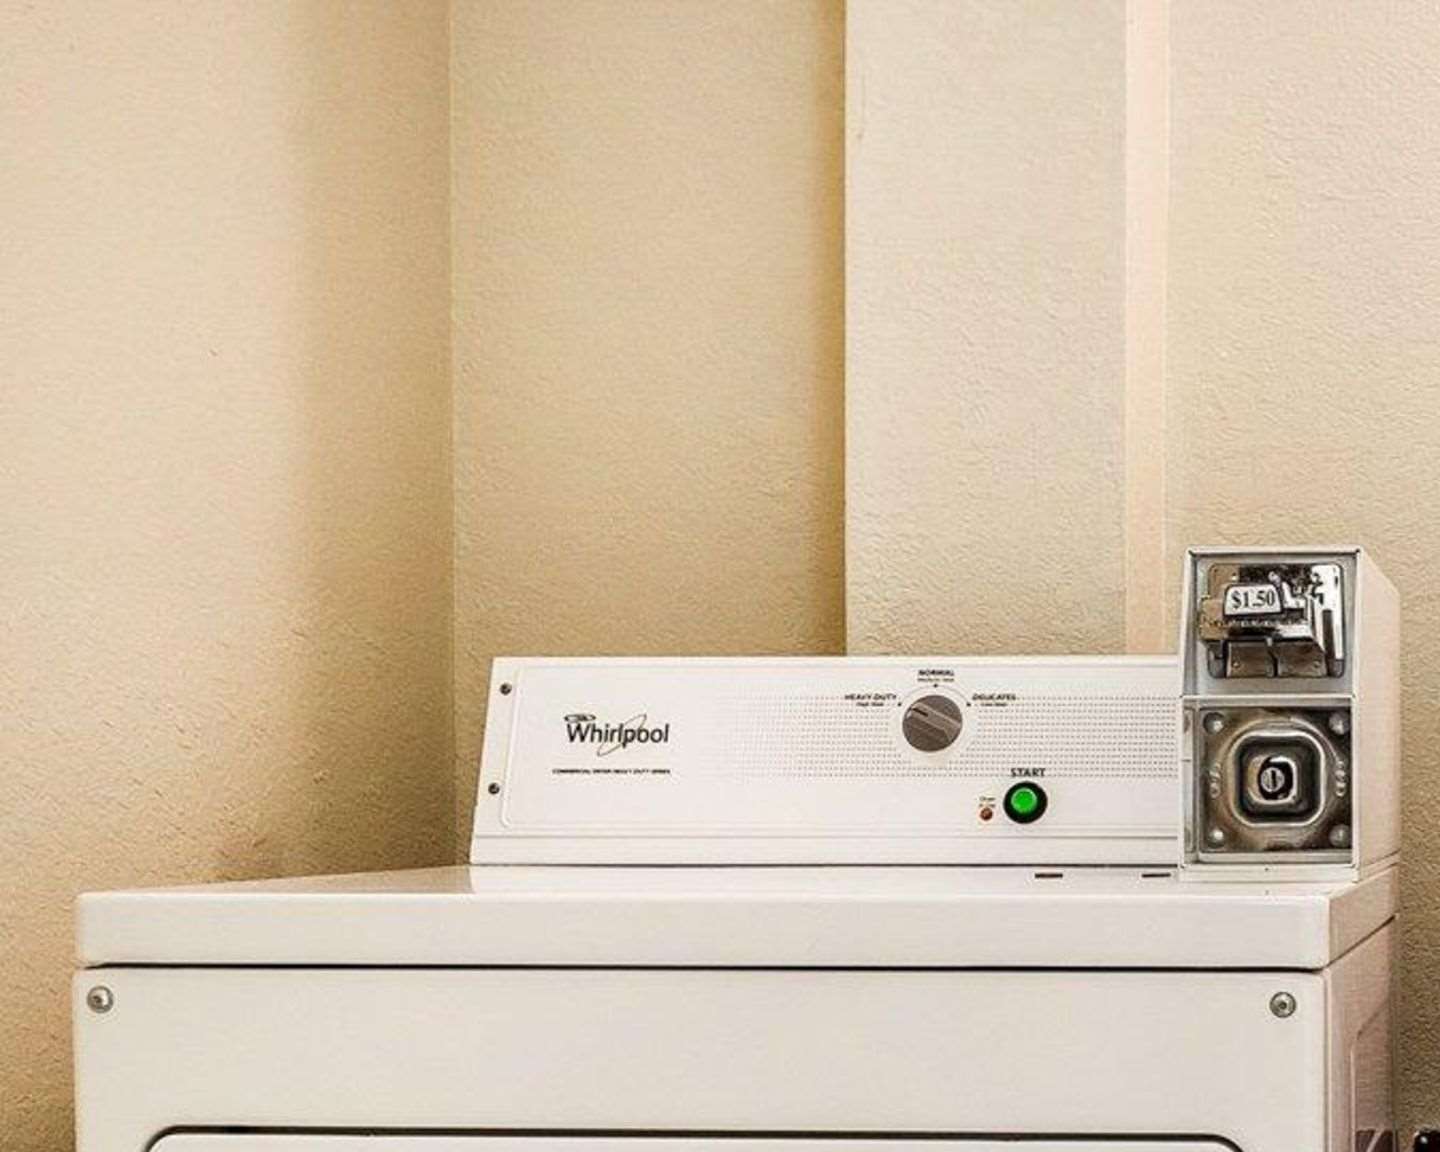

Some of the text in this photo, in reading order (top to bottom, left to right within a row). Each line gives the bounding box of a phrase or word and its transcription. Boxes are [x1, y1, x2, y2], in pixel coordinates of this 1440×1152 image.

[1231, 589, 1276, 610] $1.50
[918, 669, 955, 677] NORMAL
[844, 693, 897, 701] HEAVY DUTY
[972, 693, 1017, 701] DELICATES
[566, 722, 670, 749] Whirlpool
[1010, 767, 1047, 777] START
